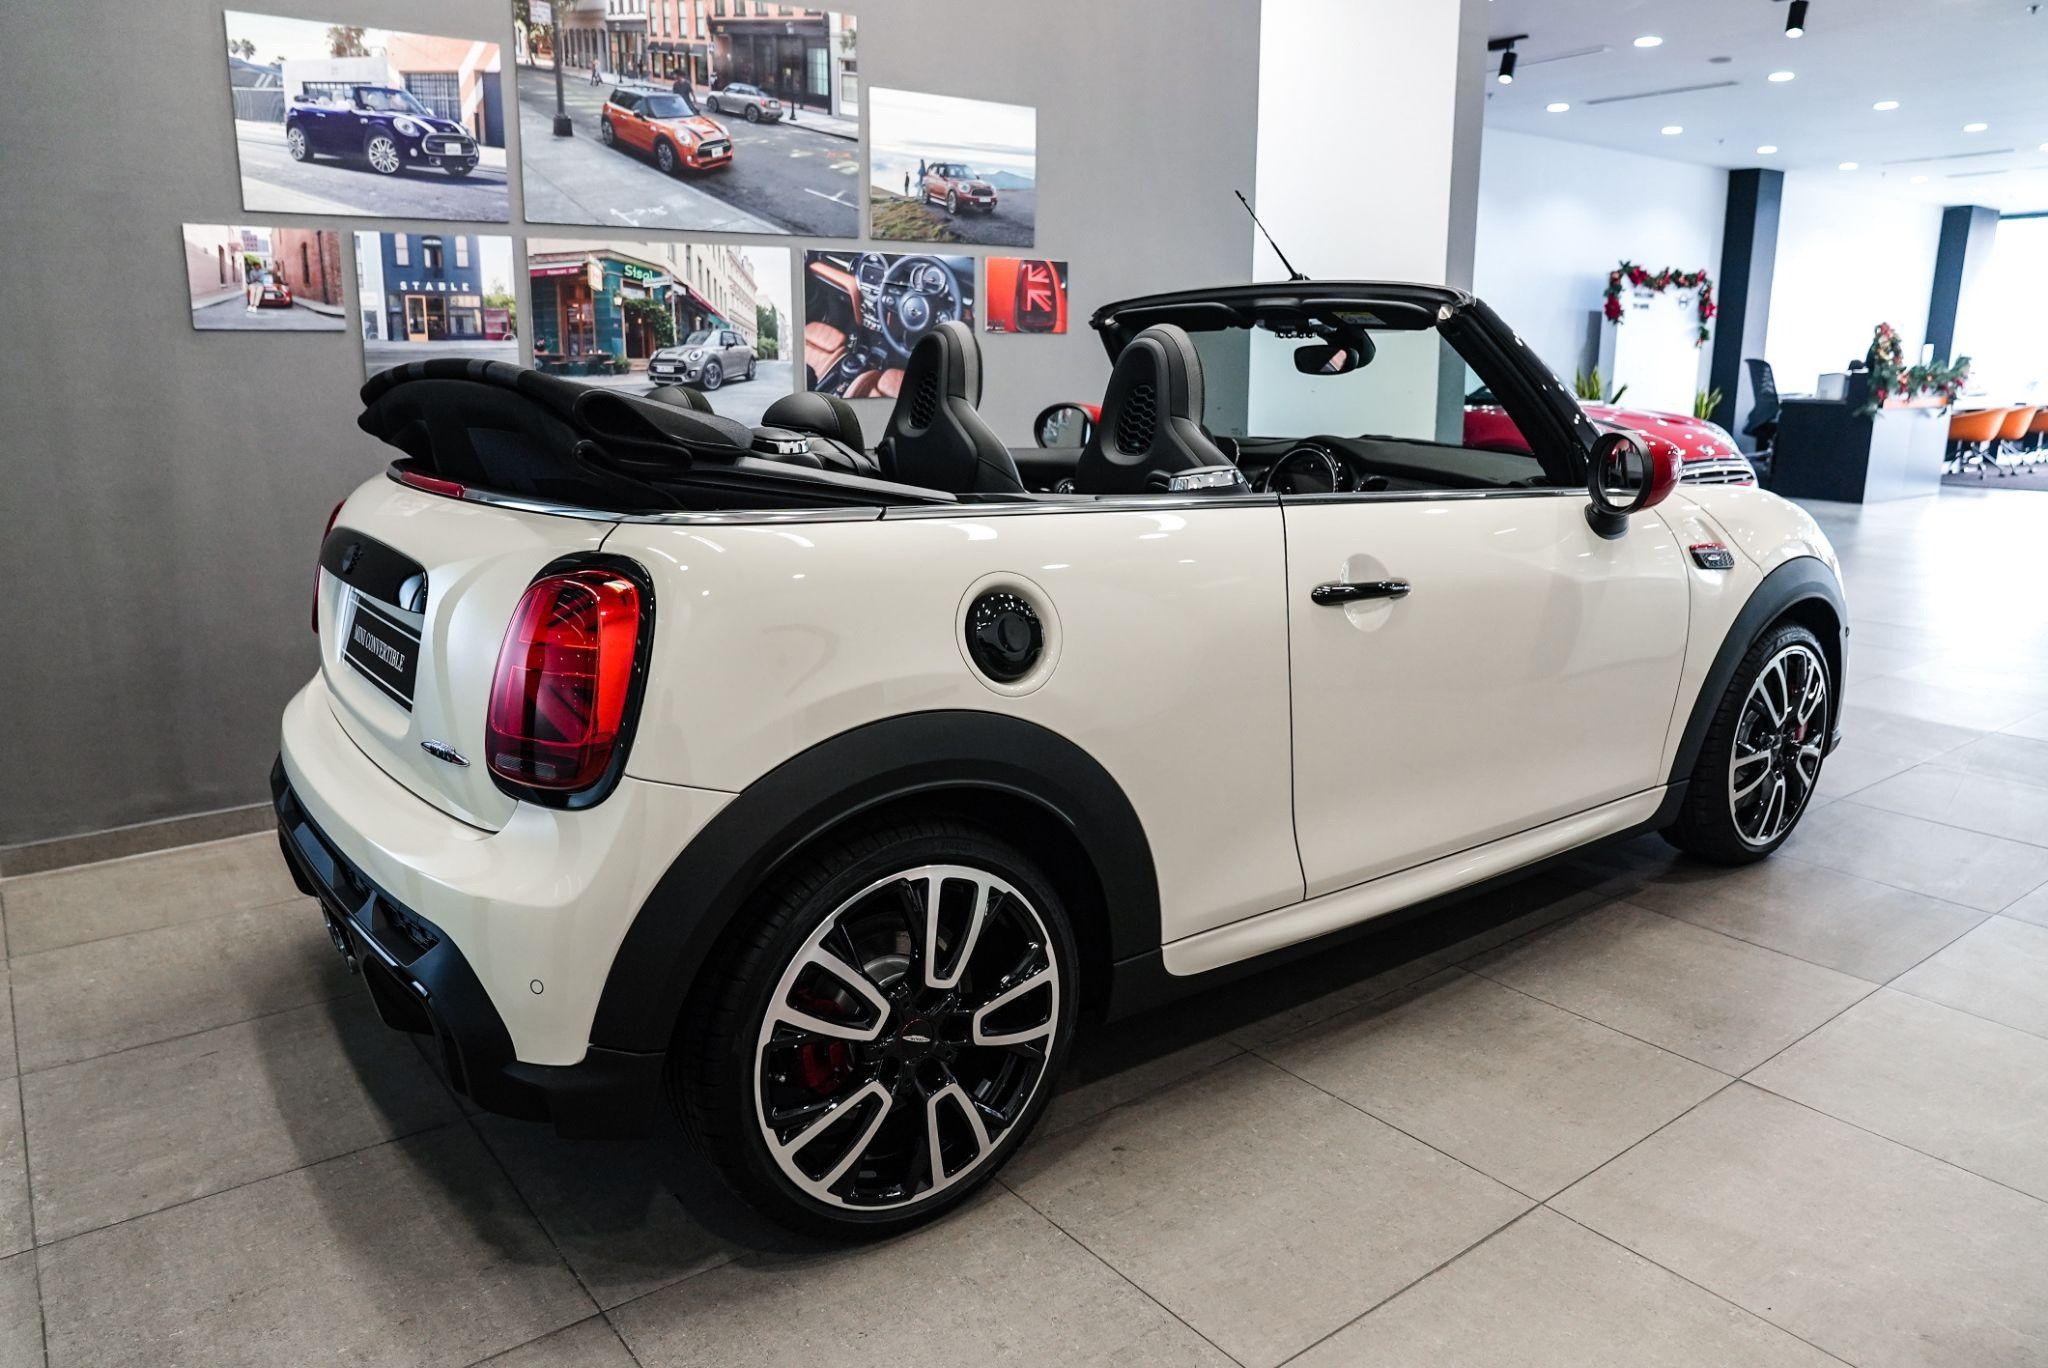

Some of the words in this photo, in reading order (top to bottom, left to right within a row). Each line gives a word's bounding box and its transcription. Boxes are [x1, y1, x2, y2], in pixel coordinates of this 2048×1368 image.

[400, 281, 469, 292] STABLE
[353, 623, 367, 647] MINI
[365, 632, 405, 673] CONVERTIBLE
